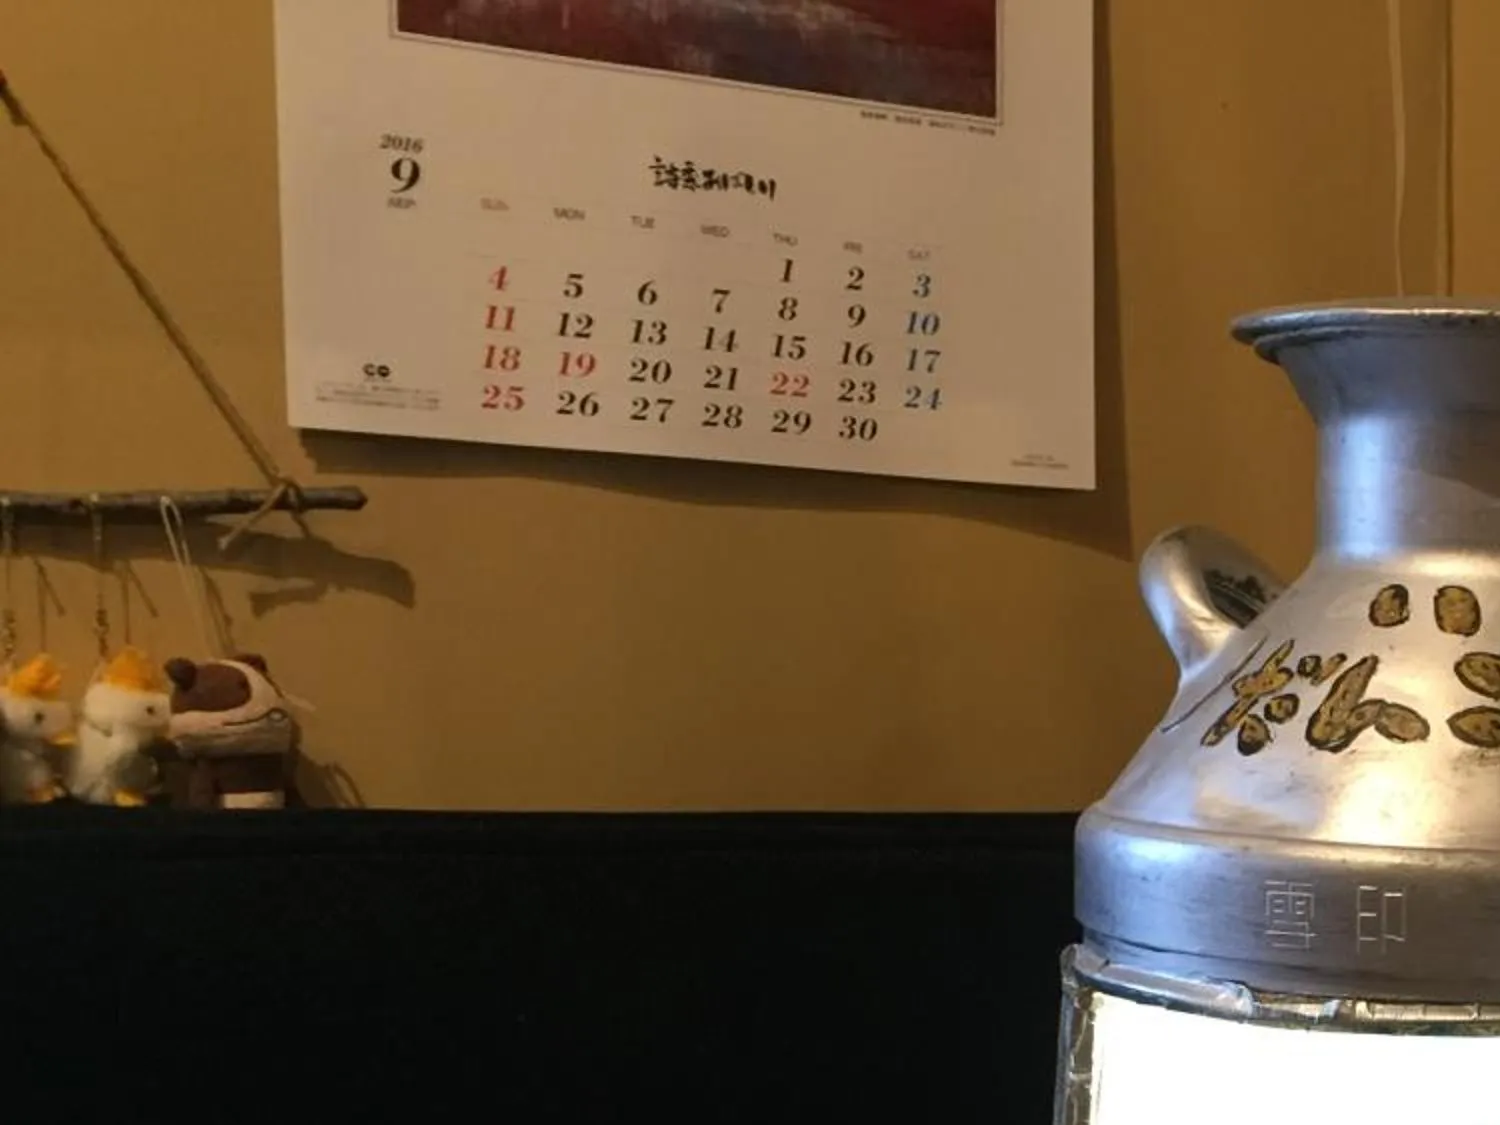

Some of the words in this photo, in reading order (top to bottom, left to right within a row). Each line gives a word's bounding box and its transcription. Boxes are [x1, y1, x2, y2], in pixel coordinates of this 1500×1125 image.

[379, 134, 423, 154] 2016
[391, 157, 420, 194] 9
[487, 264, 508, 291] 4
[564, 274, 583, 298] 5
[638, 282, 657, 305] 6
[713, 289, 730, 313] 7
[778, 298, 798, 320] 8
[848, 305, 866, 326] 9
[907, 311, 940, 335] 10
[782, 259, 793, 282] 1
[846, 267, 864, 290] 2
[913, 274, 931, 298] 3
[486, 305, 515, 331] 11
[559, 313, 593, 338] 12
[633, 320, 667, 345] 13
[703, 327, 739, 352] 14
[772, 335, 808, 359] 15
[840, 342, 875, 366] 16
[907, 349, 941, 373] 17
[484, 345, 521, 370] 18
[560, 352, 596, 376] 19
[629, 359, 671, 382] 20
[704, 366, 737, 390] 21
[770, 372, 809, 398] 22
[838, 379, 876, 403] 23
[904, 386, 941, 410] 24
[481, 385, 524, 410] 25
[557, 392, 599, 416] 26
[630, 398, 674, 423] 27
[702, 404, 743, 428] 28
[771, 410, 811, 434] 29
[839, 416, 877, 440] 30
